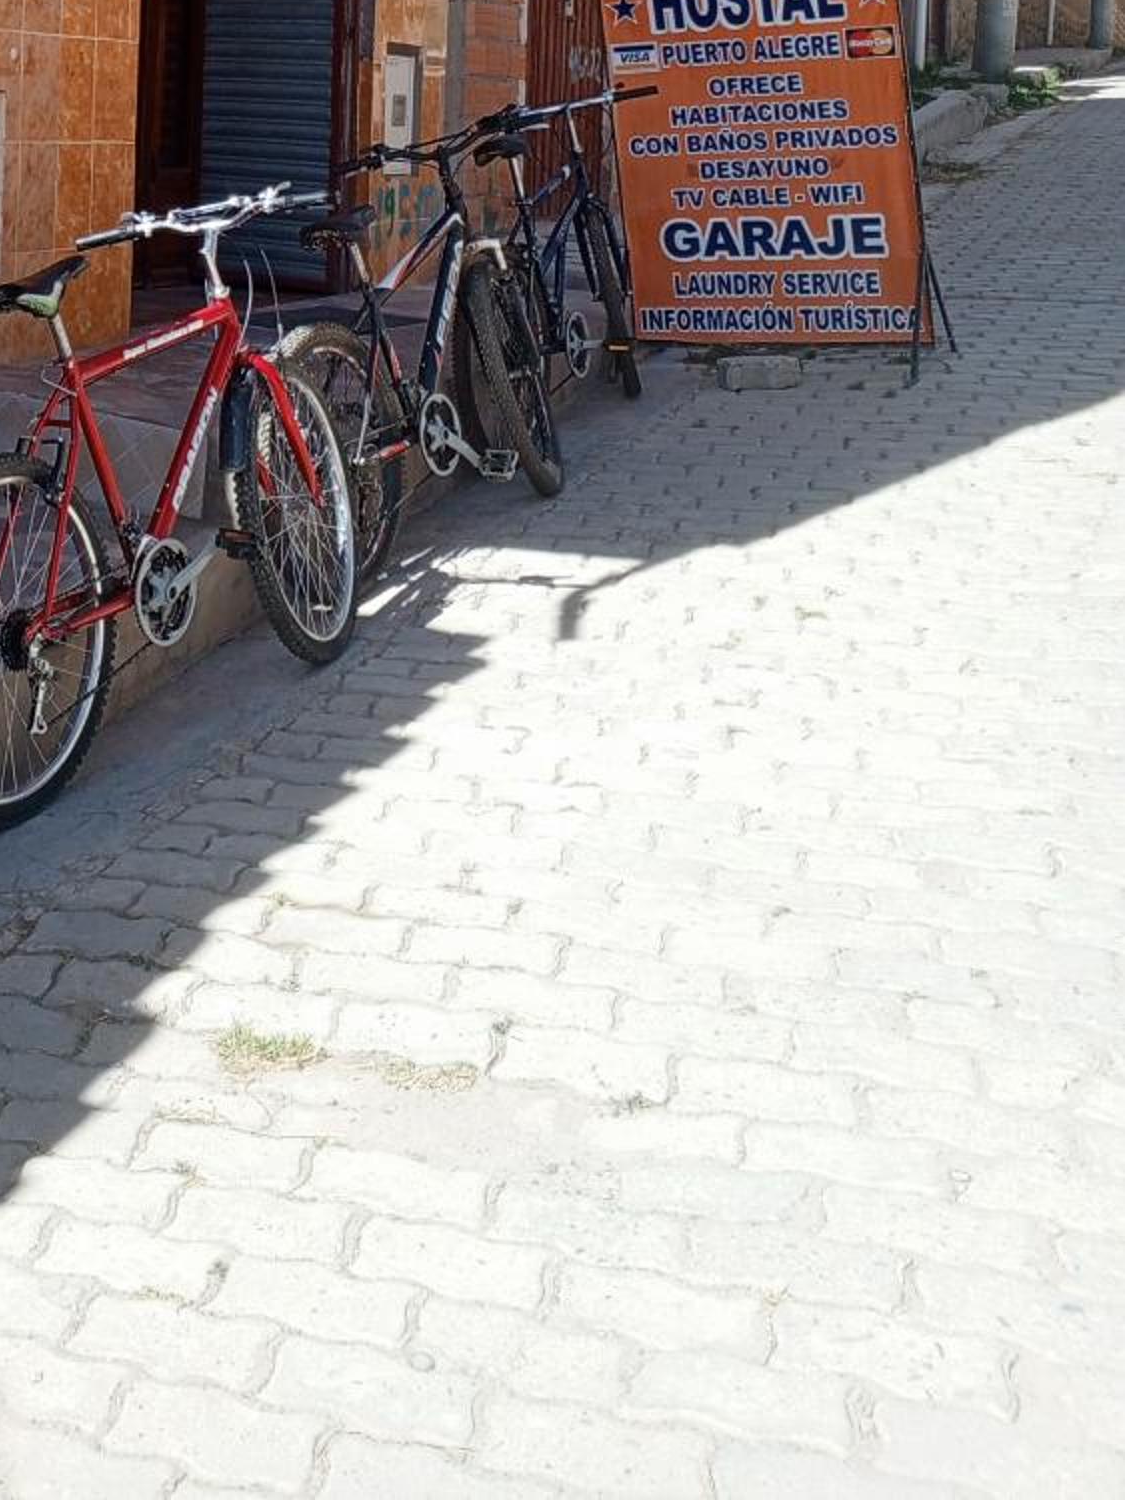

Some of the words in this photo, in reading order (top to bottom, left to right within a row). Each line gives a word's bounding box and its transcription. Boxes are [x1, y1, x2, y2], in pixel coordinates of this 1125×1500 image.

[662, 40, 746, 65] PUERTO
[754, 34, 839, 60] ALEGRE
[709, 75, 801, 96] OFRECE
[671, 100, 848, 126] HABITACIONES
[631, 137, 678, 155] CON
[687, 127, 767, 154] BAÑOS
[776, 127, 897, 149] PRIVADOS
[700, 158, 829, 180] DESAYUNO
[673, 189, 703, 207] TV
[712, 186, 789, 206] CABLE
[810, 184, 863, 205] WIFI
[662, 217, 887, 259] GARAJE
[675, 272, 775, 298] LAUNDRY
[784, 271, 879, 296] SERVICE
[642, 302, 792, 332] INFORMACIÓN
[800, 301, 922, 332] TURÍSTICA
